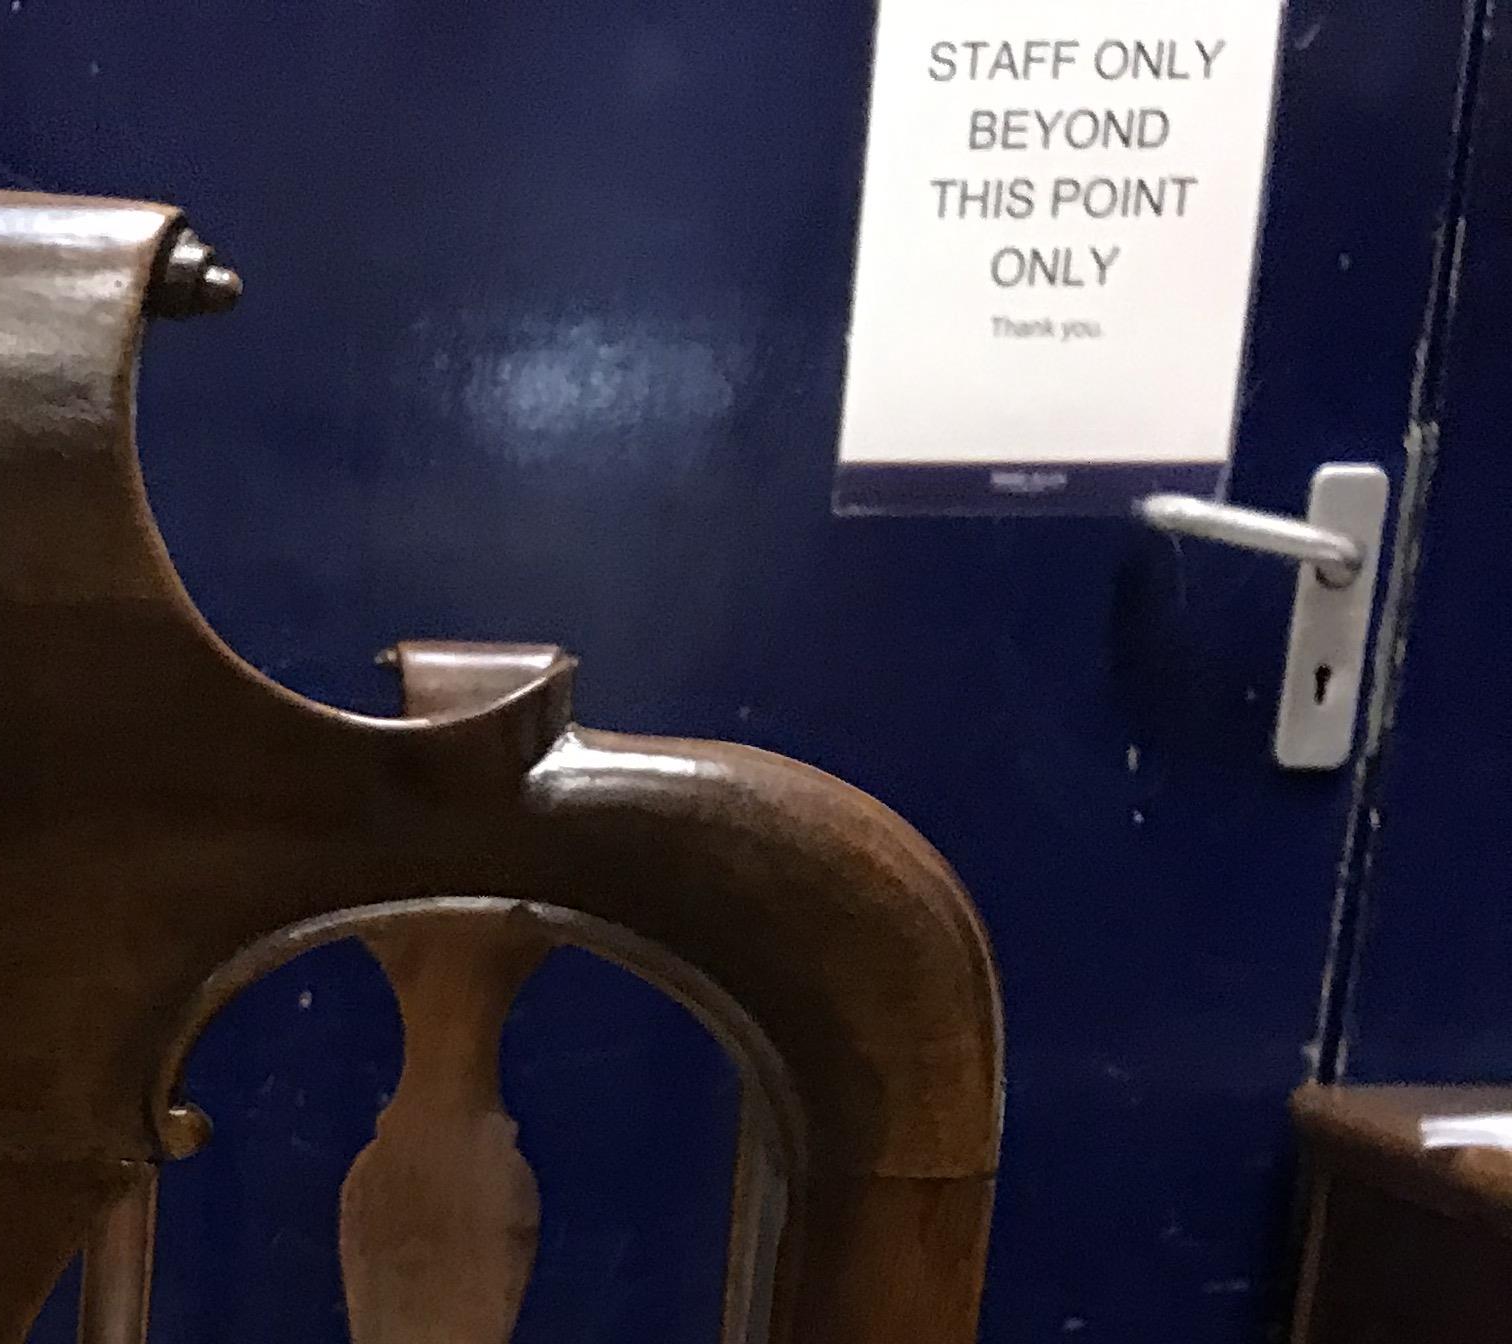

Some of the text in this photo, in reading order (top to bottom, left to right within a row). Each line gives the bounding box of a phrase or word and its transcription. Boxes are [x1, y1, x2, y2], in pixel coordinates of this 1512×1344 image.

[928, 39, 1226, 81] STAFF ONLY
[968, 108, 1170, 150] BEYOND
[929, 176, 1198, 220] THIS POINT
[990, 246, 1120, 288] ONLY
[992, 315, 1054, 338] Thank
